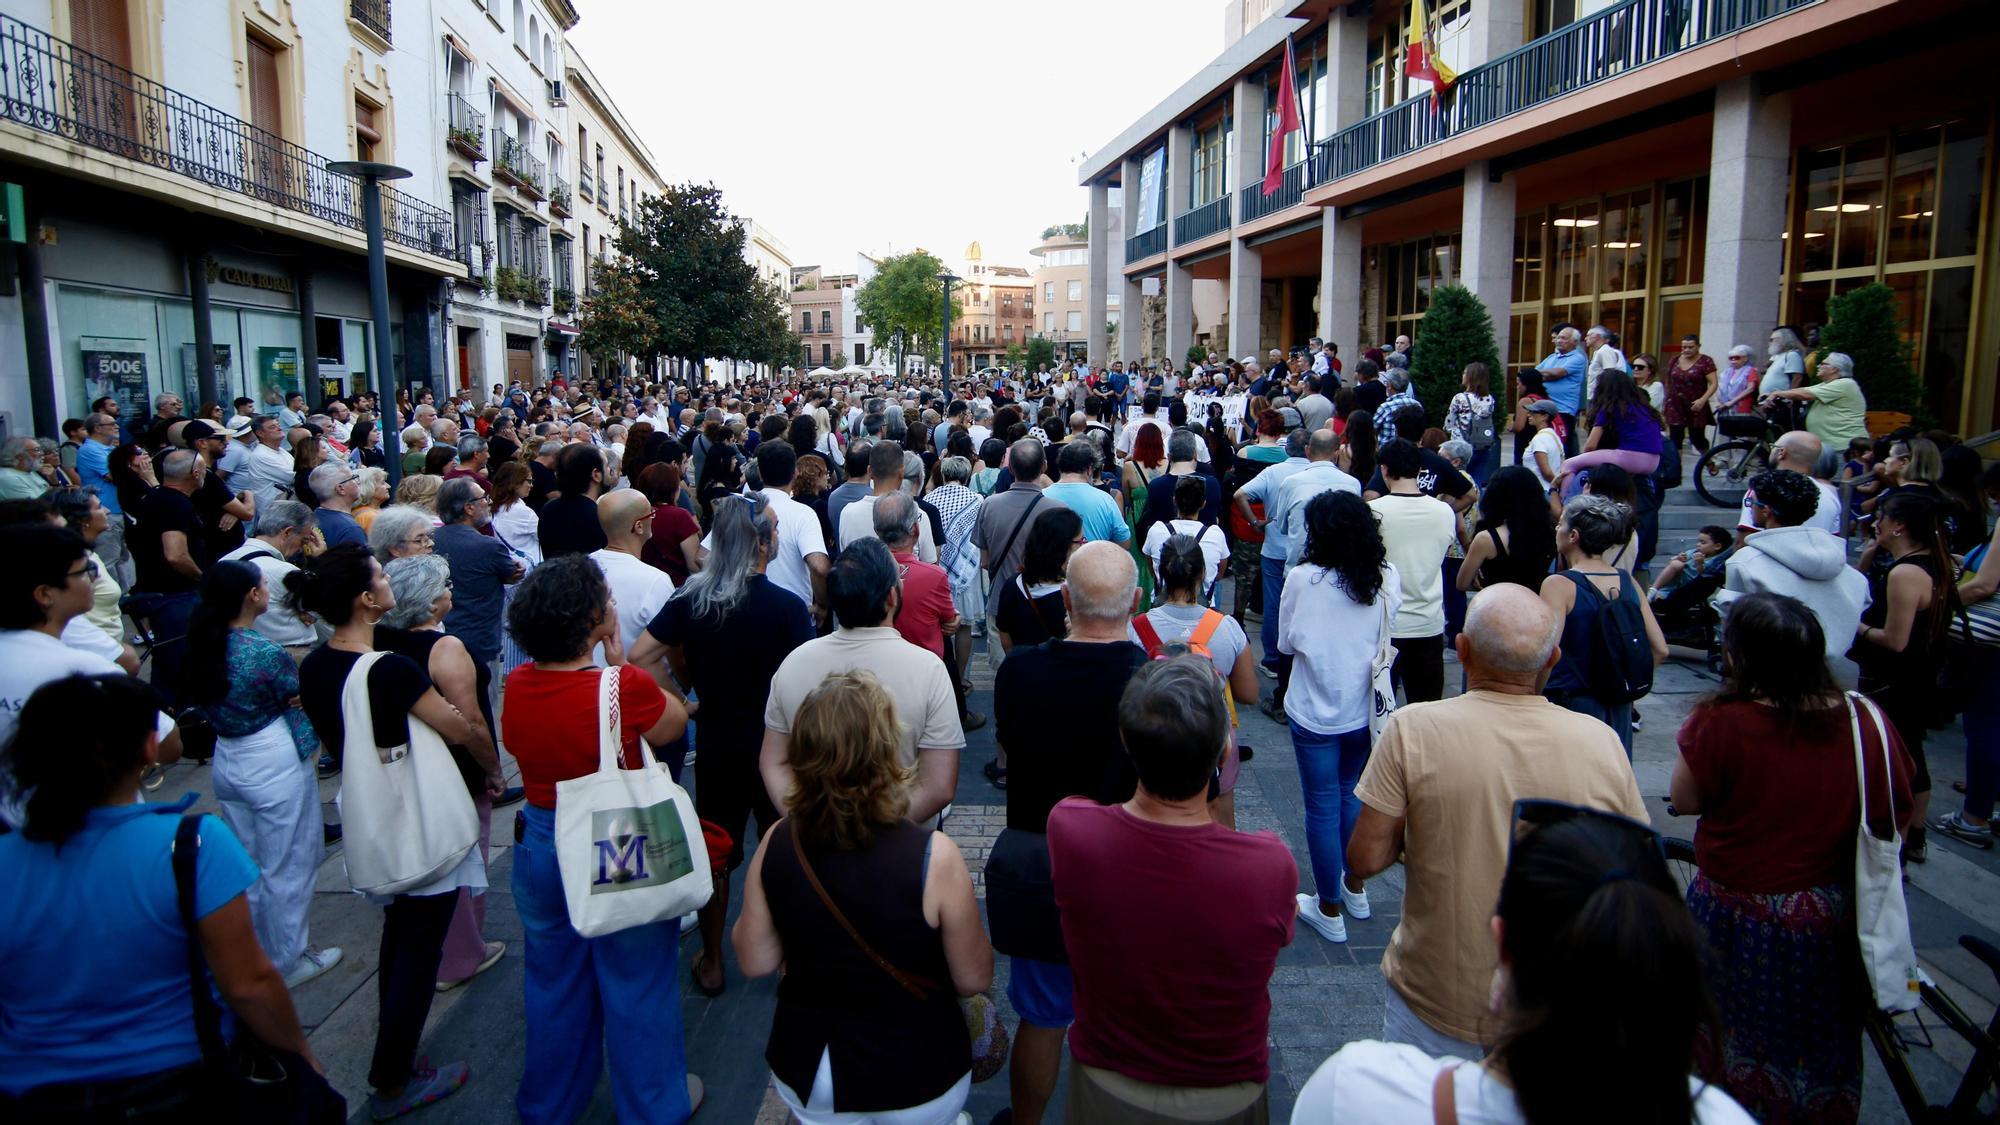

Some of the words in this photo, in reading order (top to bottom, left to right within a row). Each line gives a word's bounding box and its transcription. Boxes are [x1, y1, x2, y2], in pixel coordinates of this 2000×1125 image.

[224, 268, 256, 287] CAJA
[258, 274, 295, 293] RURAL
[100, 359, 142, 374] 500€
[593, 835, 649, 885] M
